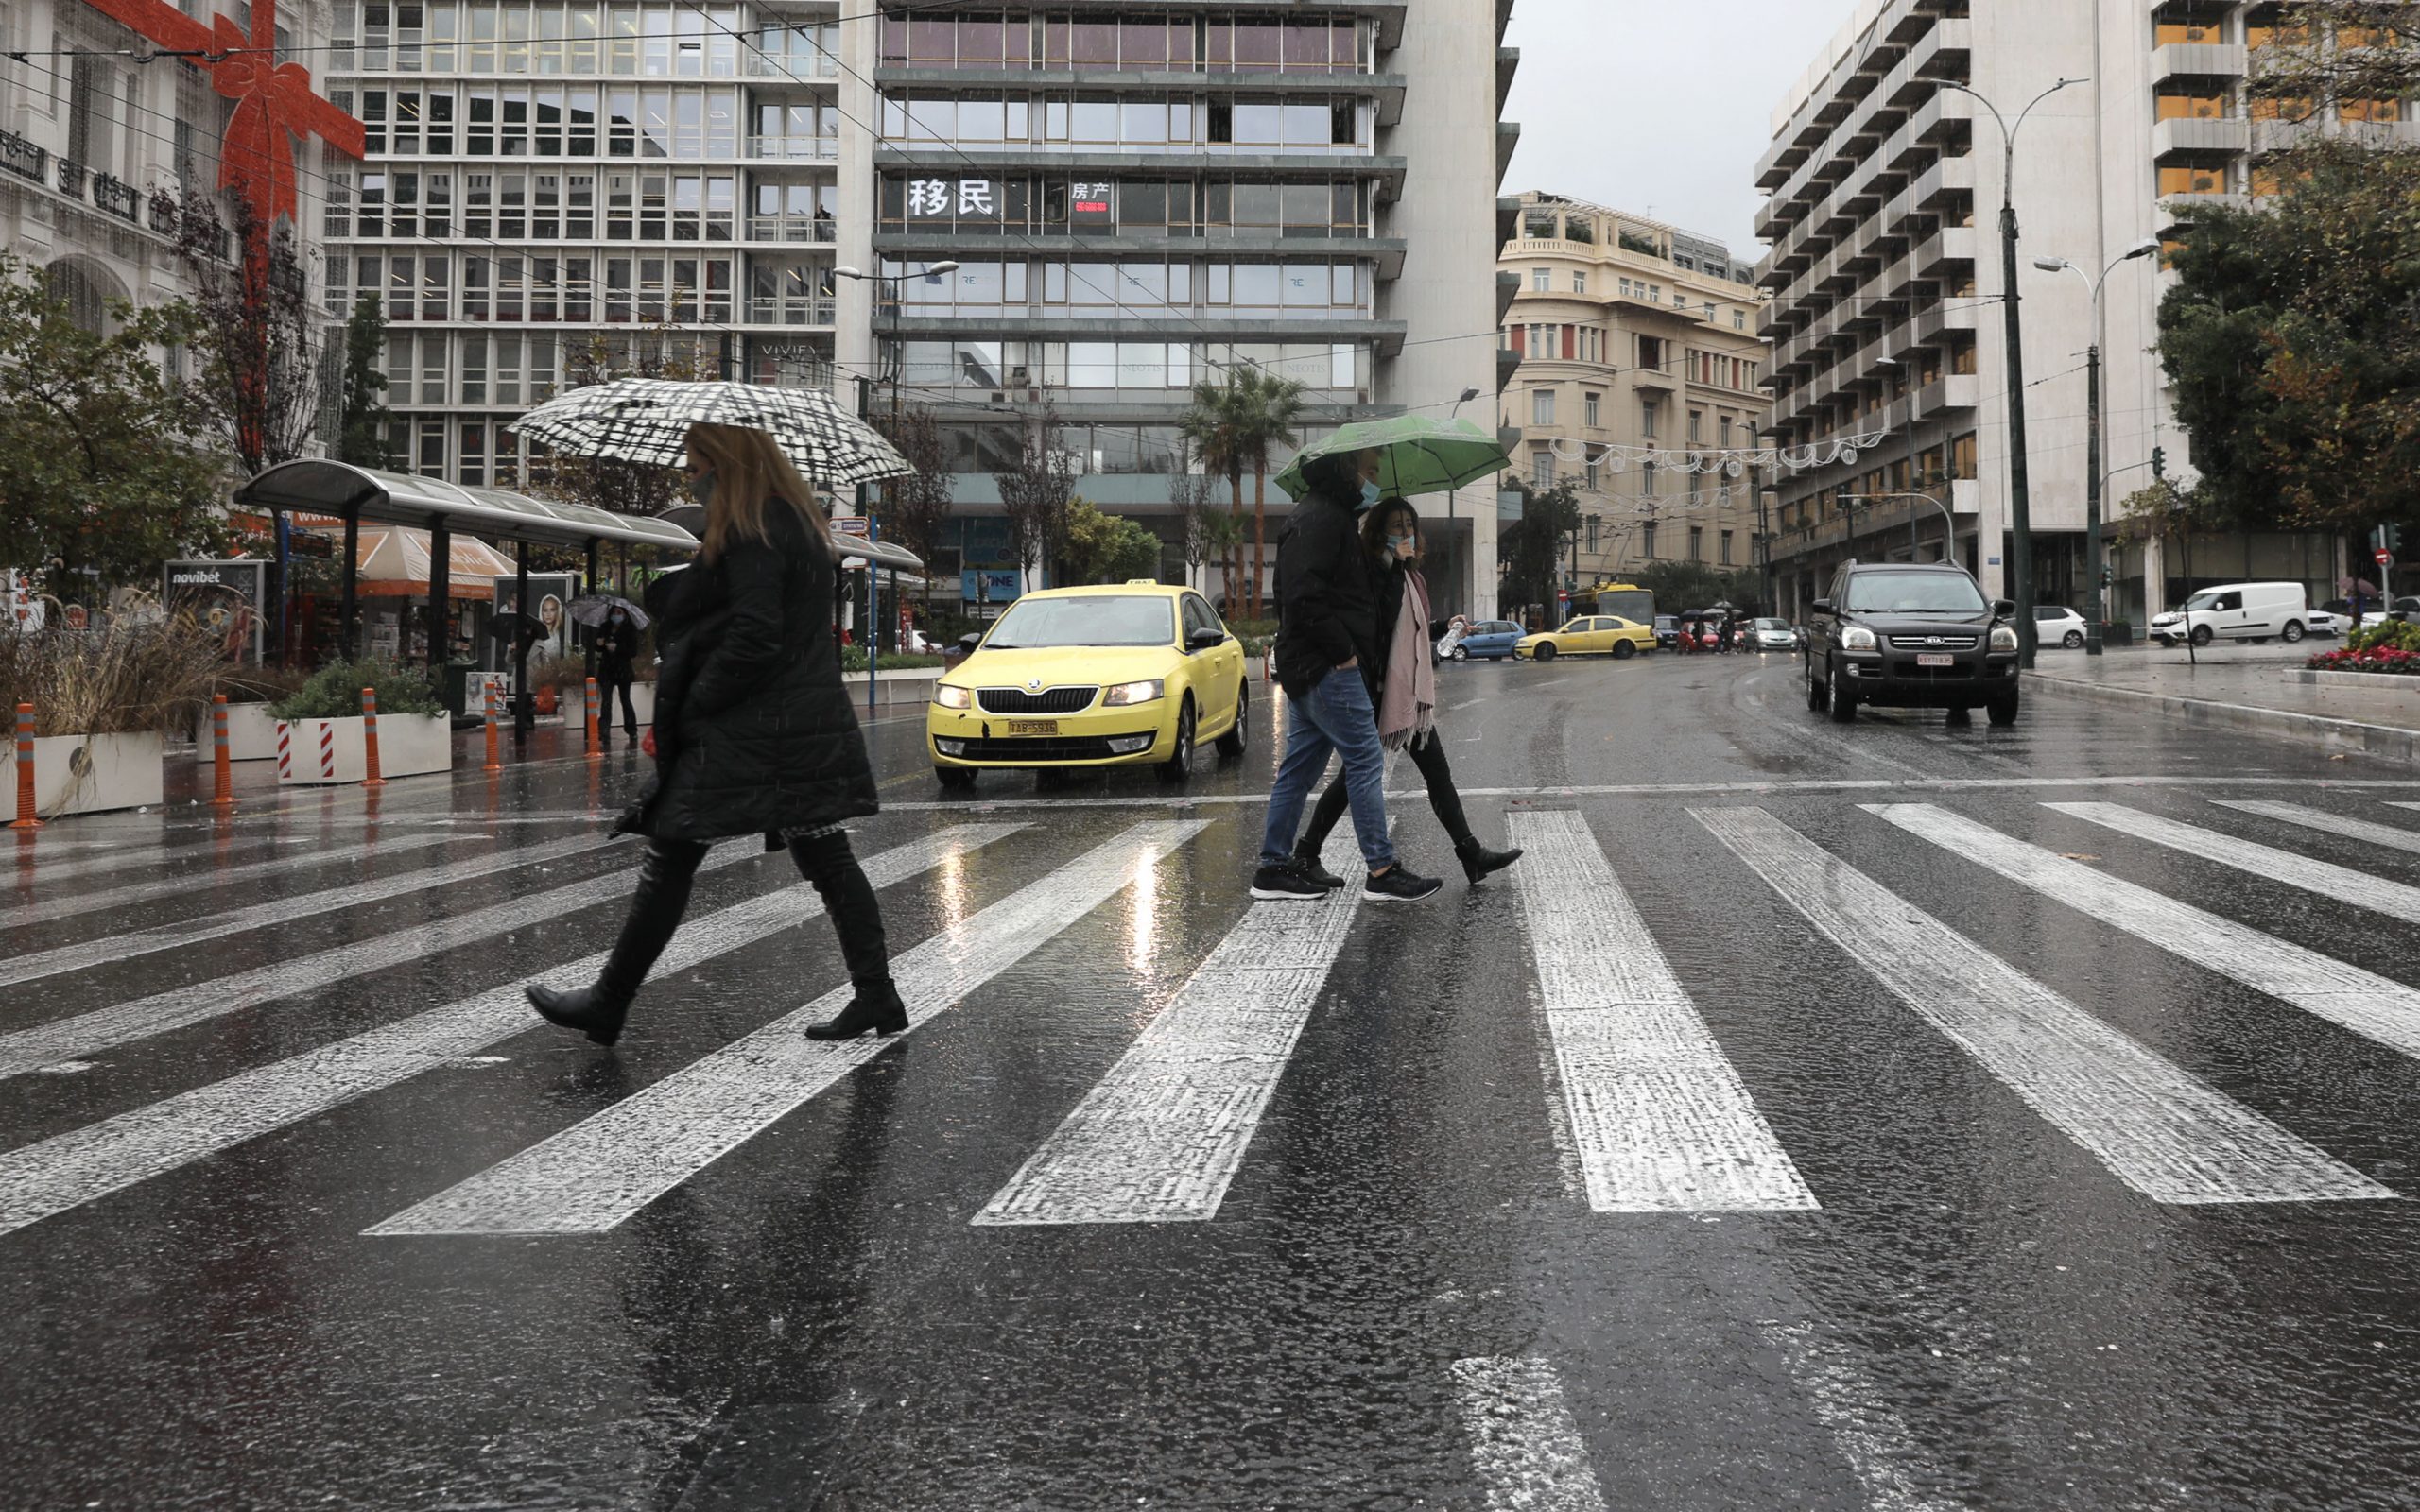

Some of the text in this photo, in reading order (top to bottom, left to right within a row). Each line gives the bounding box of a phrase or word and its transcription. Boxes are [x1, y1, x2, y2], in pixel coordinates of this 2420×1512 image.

[909, 179, 993, 215] 移民
[1072, 182, 1109, 199] 房产
[173, 571, 220, 583] novibet
